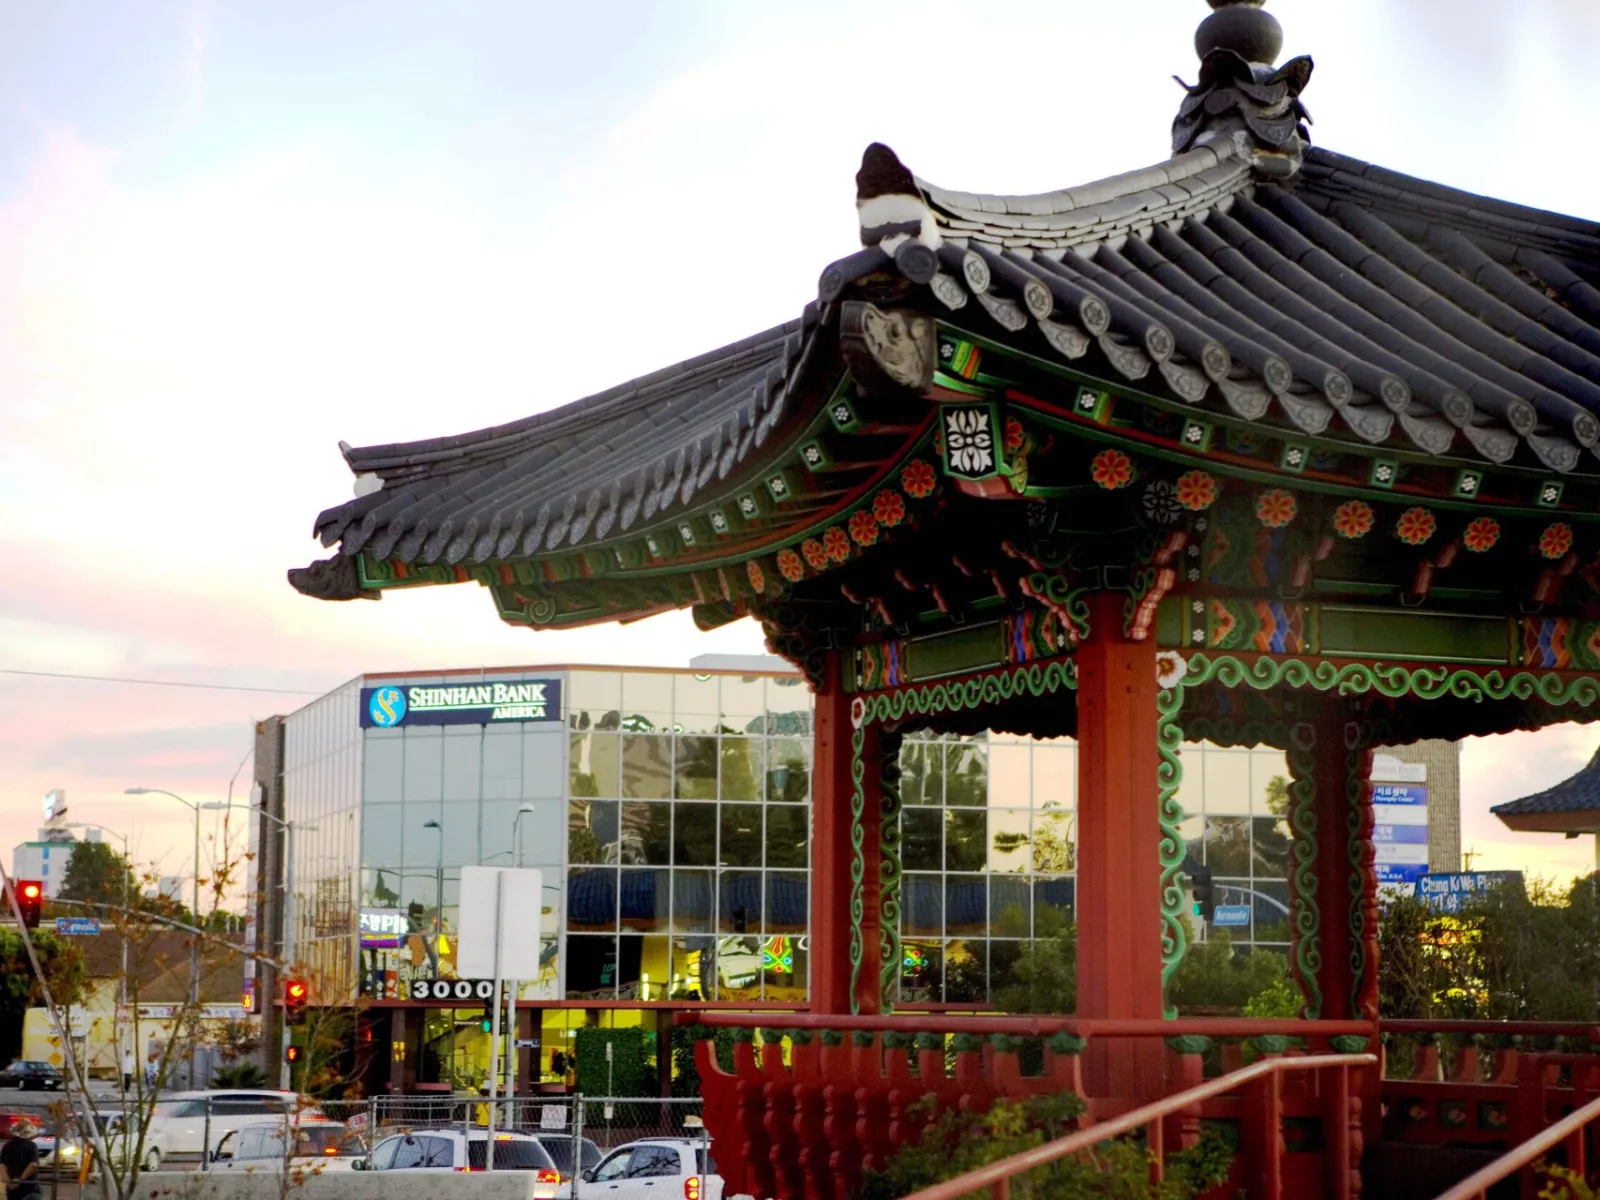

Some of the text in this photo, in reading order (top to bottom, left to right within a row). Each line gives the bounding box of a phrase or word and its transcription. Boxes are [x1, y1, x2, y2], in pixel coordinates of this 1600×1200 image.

[409, 683, 547, 708] SHINHAN BANK
[492, 706, 547, 719] AMERICA
[1421, 876, 1449, 894] Chung
[1450, 875, 1460, 892] Ki
[413, 981, 493, 999] 3000
